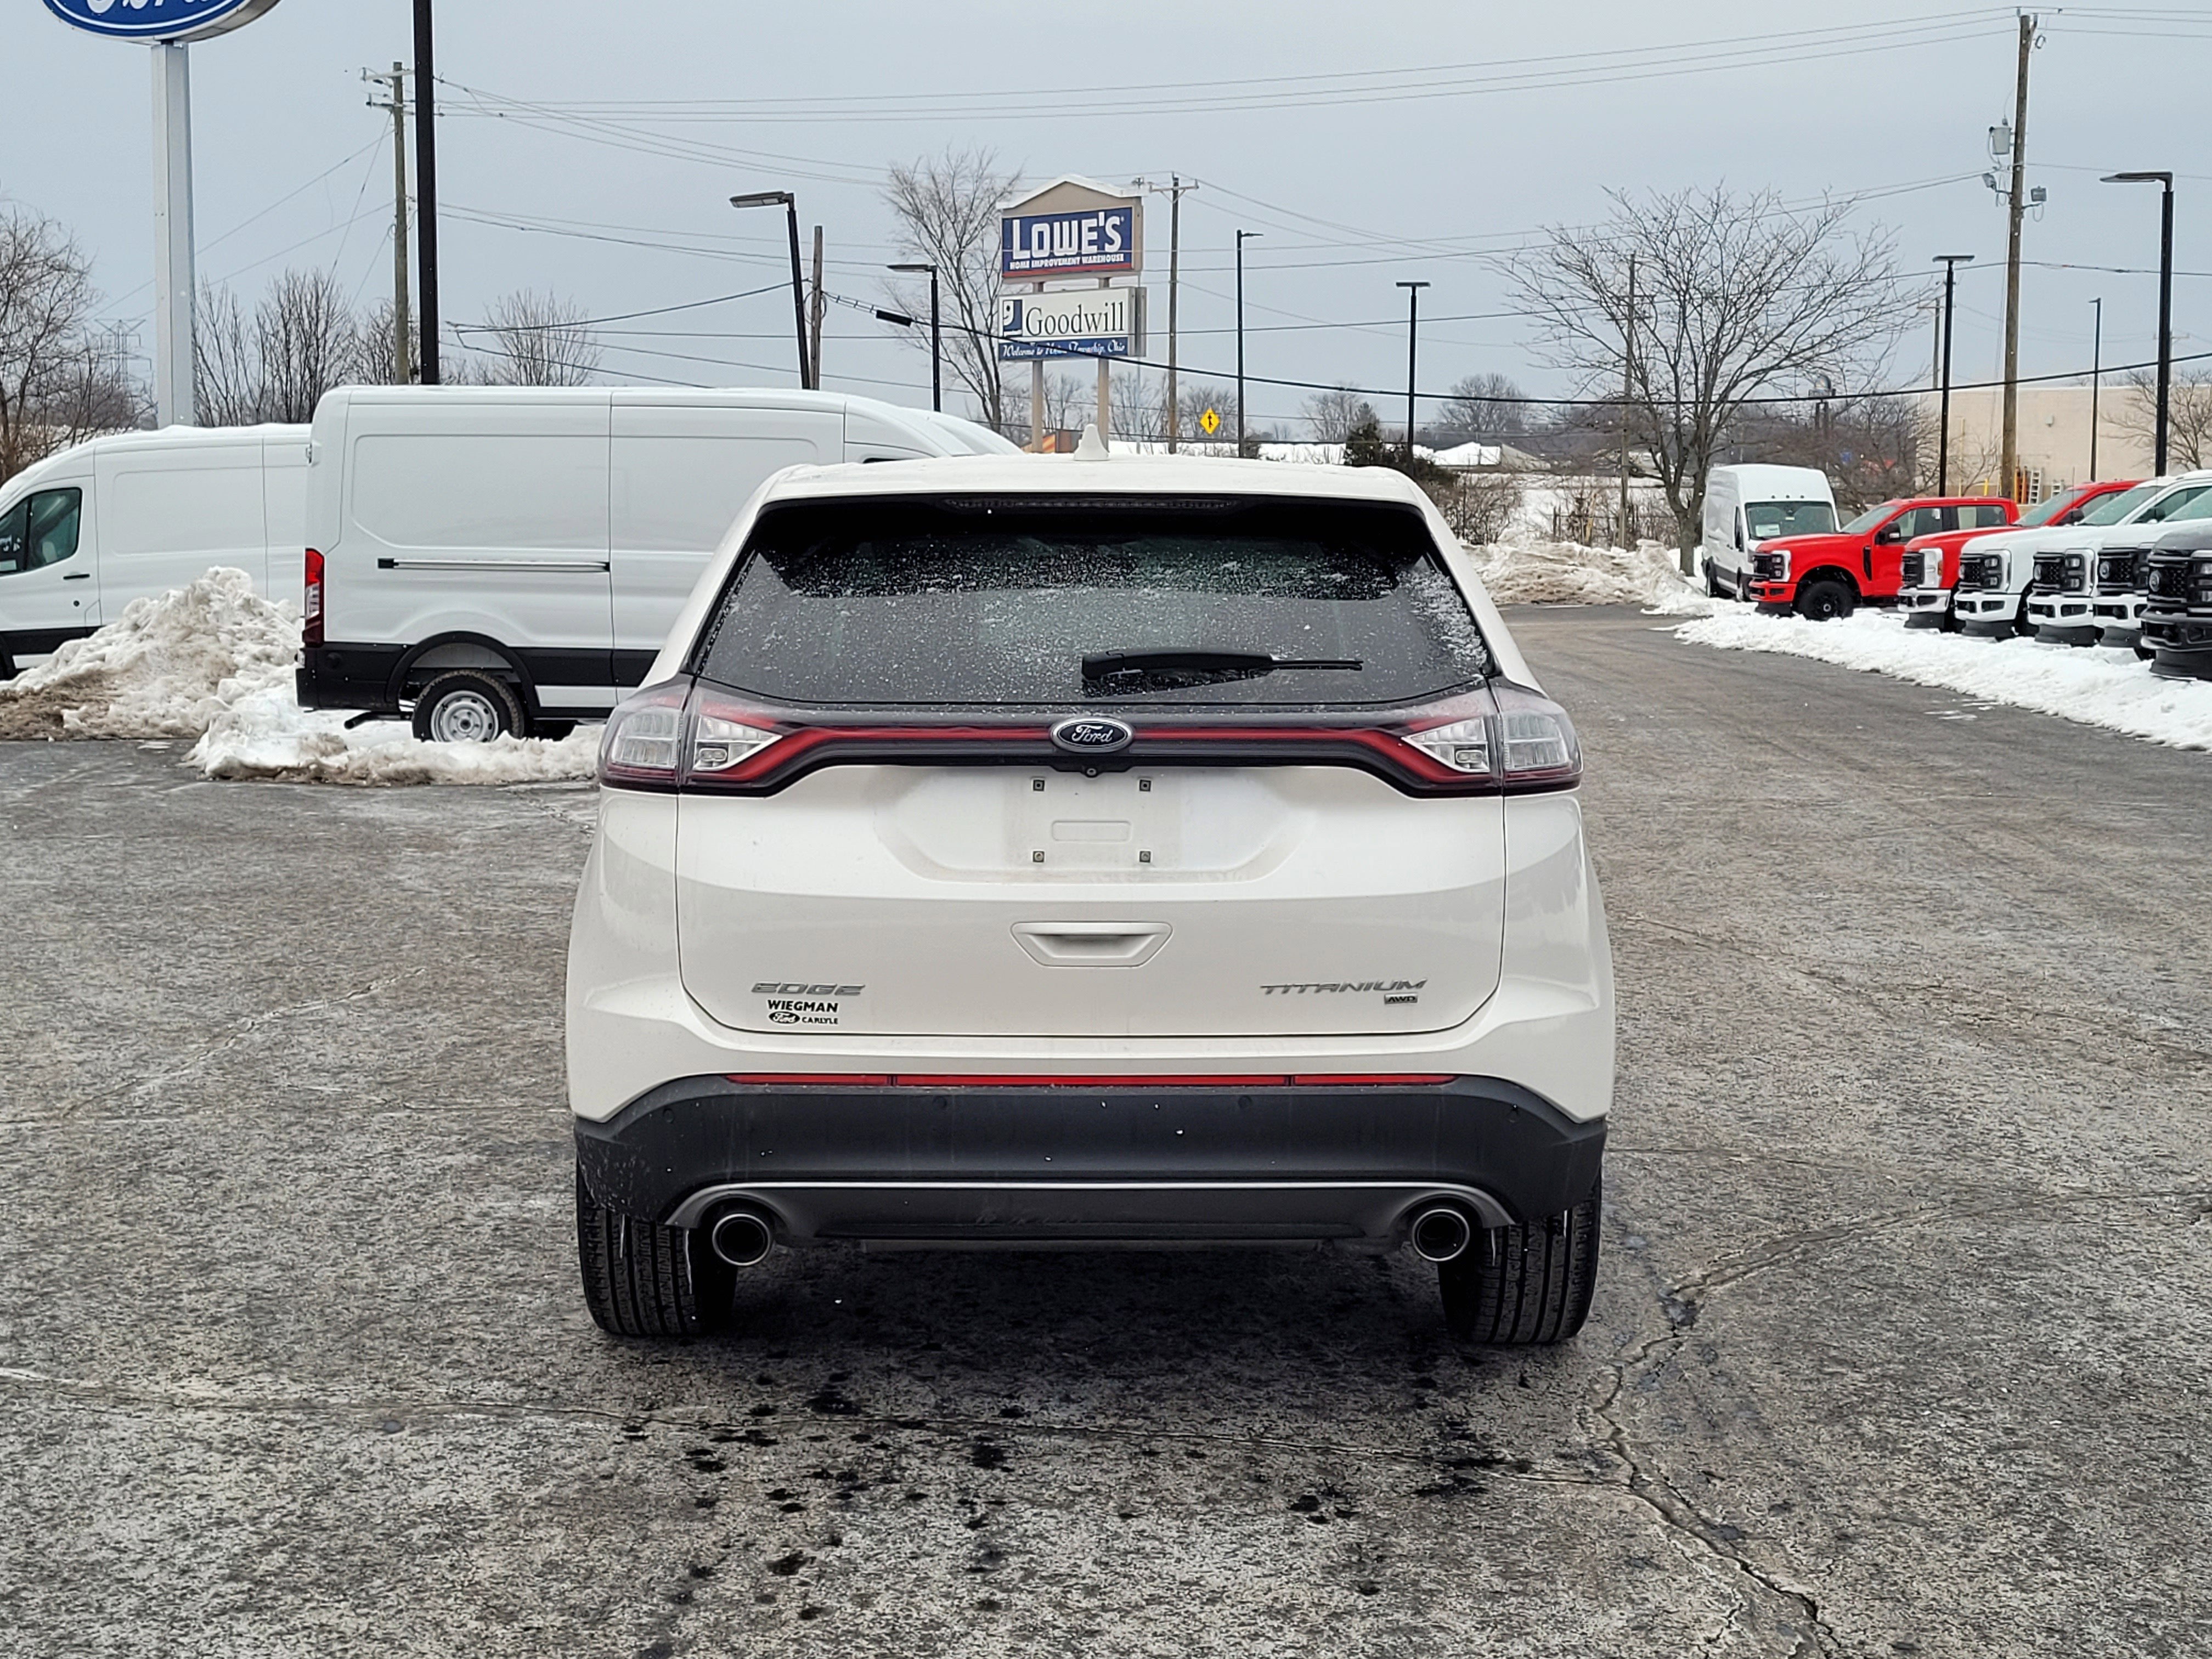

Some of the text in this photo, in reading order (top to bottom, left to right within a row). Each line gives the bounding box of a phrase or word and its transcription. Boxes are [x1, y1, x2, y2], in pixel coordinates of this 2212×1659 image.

[1013, 211, 1122, 259] LOWE'S
[1009, 253, 1124, 270] HOME IMPROVEMENT WAREHOUSE
[1025, 301, 1125, 337] Goodwill
[1002, 345, 1035, 357] Welcome
[1107, 339, 1125, 353] Ohio
[1071, 724, 1114, 743] Ford
[751, 982, 866, 996] EDGE
[1260, 979, 1428, 995] TITANIUM
[767, 999, 839, 1013] WIEGMAN
[772, 1012, 797, 1024] Ford
